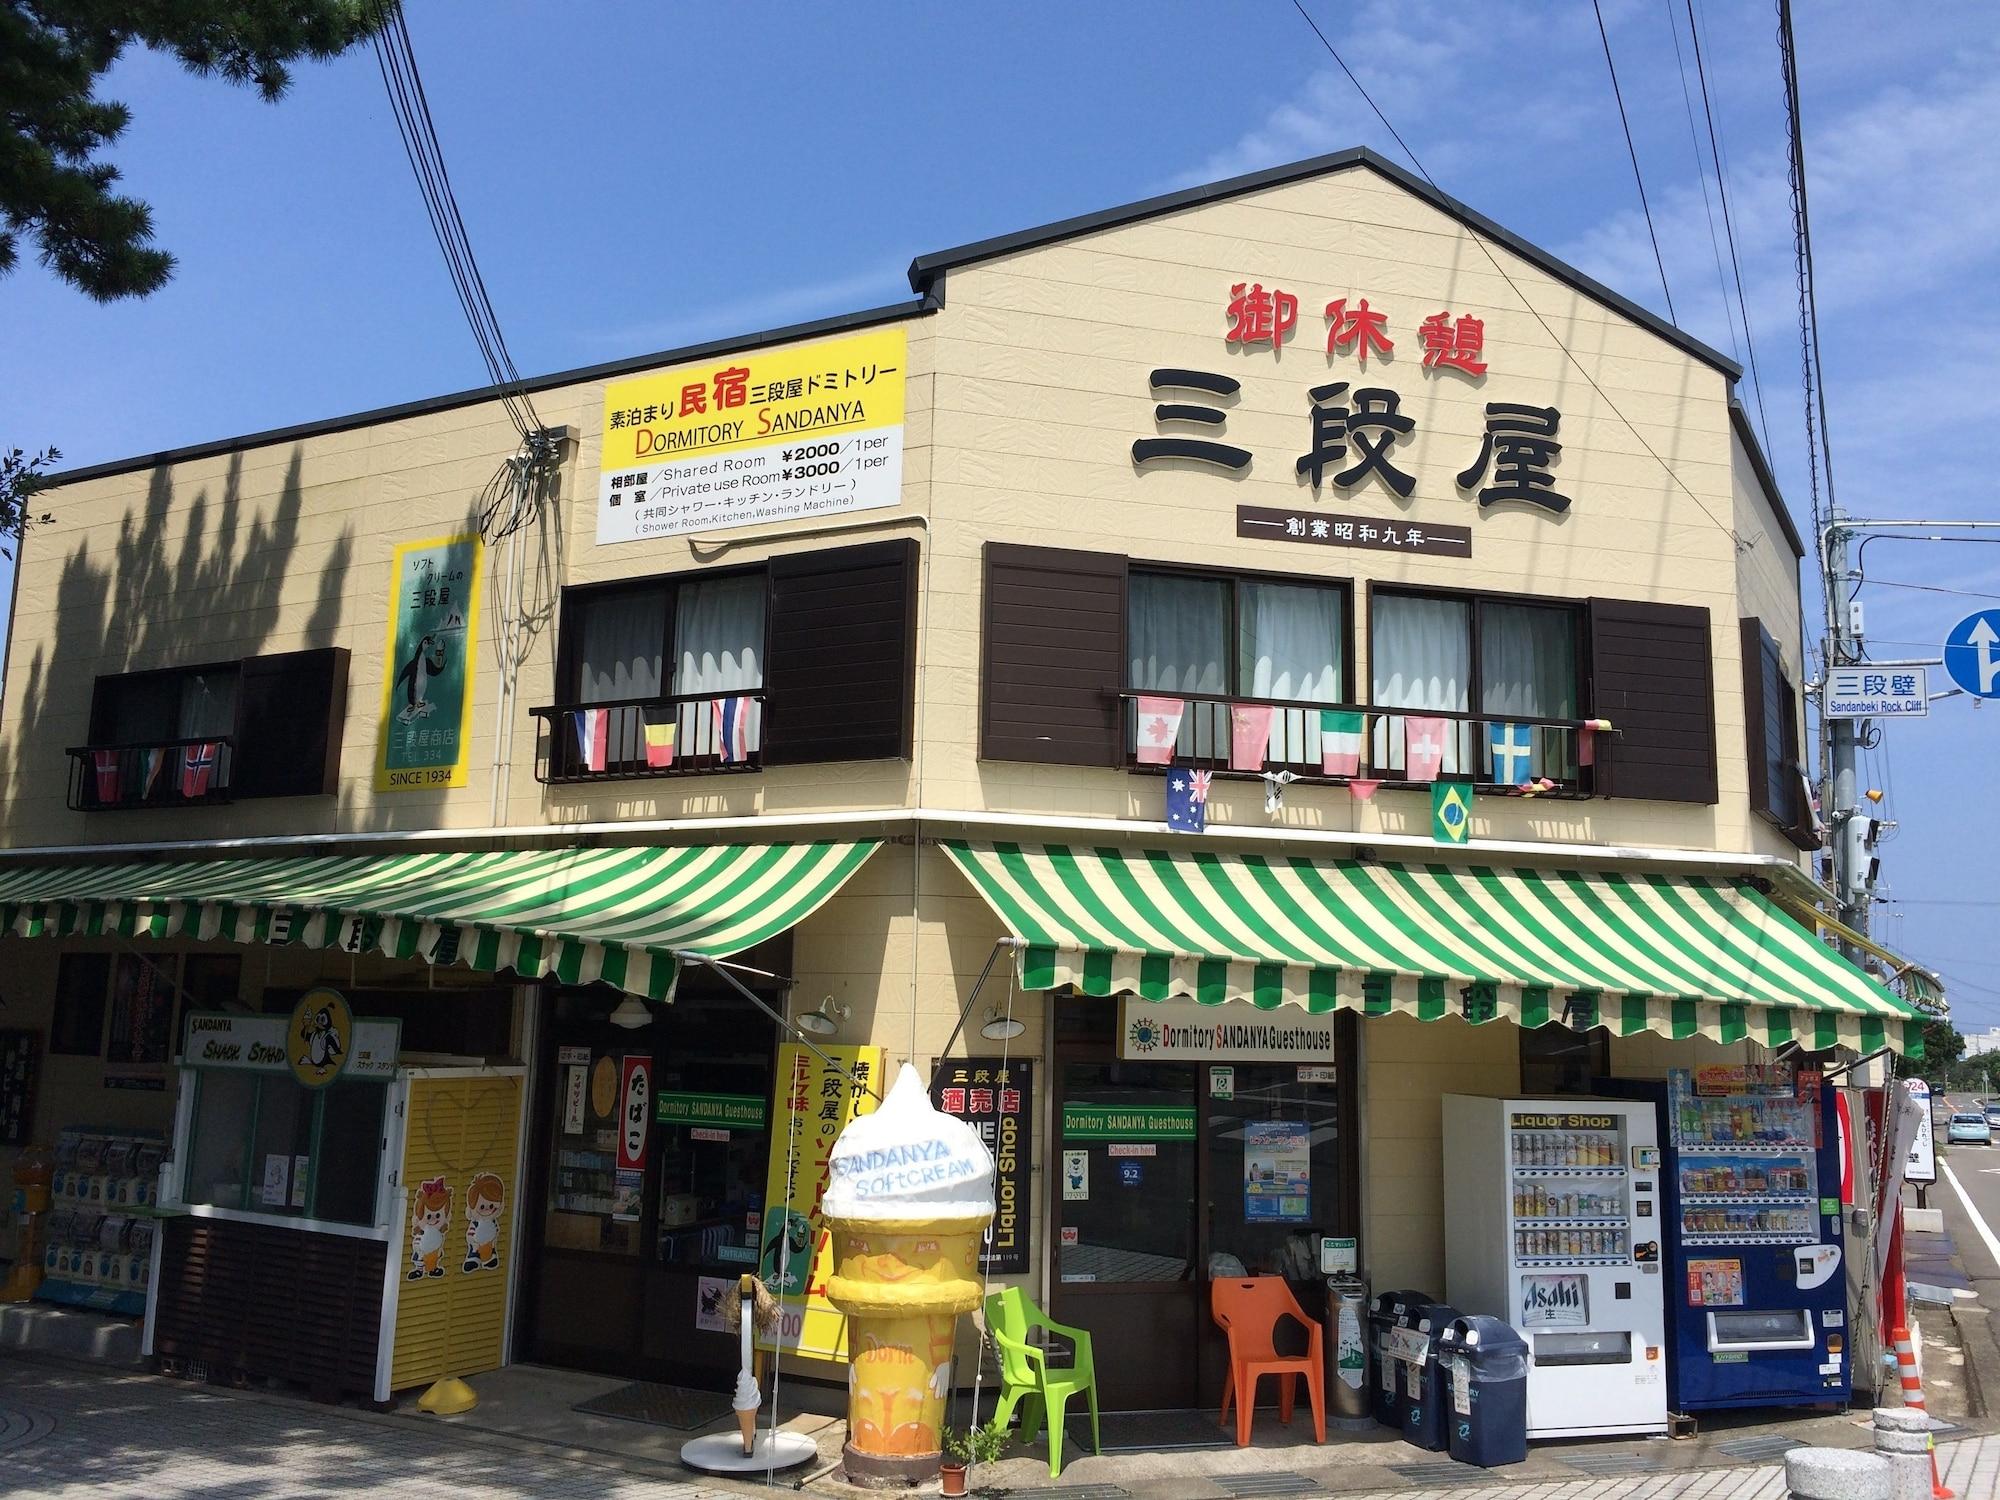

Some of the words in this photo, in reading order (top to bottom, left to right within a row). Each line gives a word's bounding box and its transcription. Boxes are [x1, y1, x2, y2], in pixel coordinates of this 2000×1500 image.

[1226, 282, 1488, 378] 御休憩
[757, 400, 865, 436] SANDANYA
[1131, 368, 1573, 515] 三段屋
[610, 472, 648, 489] 相部屋
[723, 454, 766, 475] Room
[714, 477, 739, 493] use
[742, 471, 781, 488] Room
[1285, 517, 1426, 547] 創業昭和九年
[410, 587, 450, 609] 三段屋
[1835, 674, 1916, 696] 三段壁
[1830, 700, 1879, 713] Sandanbeki
[1881, 701, 1902, 713] Rock
[1905, 700, 1922, 712] Cliff
[390, 771, 422, 786] SINCE
[425, 769, 452, 784] 1934
[191, 1018, 232, 1034] SANDANYA
[1163, 1024, 1215, 1050] Dormitory
[1216, 1024, 1268, 1048] SANDANYA
[1269, 1024, 1330, 1051] Guesthouse
[953, 1069, 1010, 1084] 三段屋
[659, 1100, 689, 1116] Dormitory
[692, 1102, 723, 1117] SANDANYA
[725, 1104, 763, 1120] Guesthouse
[941, 1087, 1020, 1113] 酒売店
[629, 1074, 648, 1151] たばこ
[1065, 1114, 1104, 1132] Dormitory
[1107, 1114, 1146, 1130] SANDANYA
[1149, 1114, 1194, 1130] Guesthouse
[1511, 1114, 1566, 1129] Liquor
[1568, 1115, 1612, 1129] Shop
[998, 1116, 1019, 1173] Shop
[1124, 1169, 1138, 1179] 9.2
[997, 1177, 1018, 1247] Liquor
[720, 1248, 758, 1262] ENTRANCE
[1524, 1280, 1579, 1311] Asahi
[1545, 1308, 1556, 1320] 生
